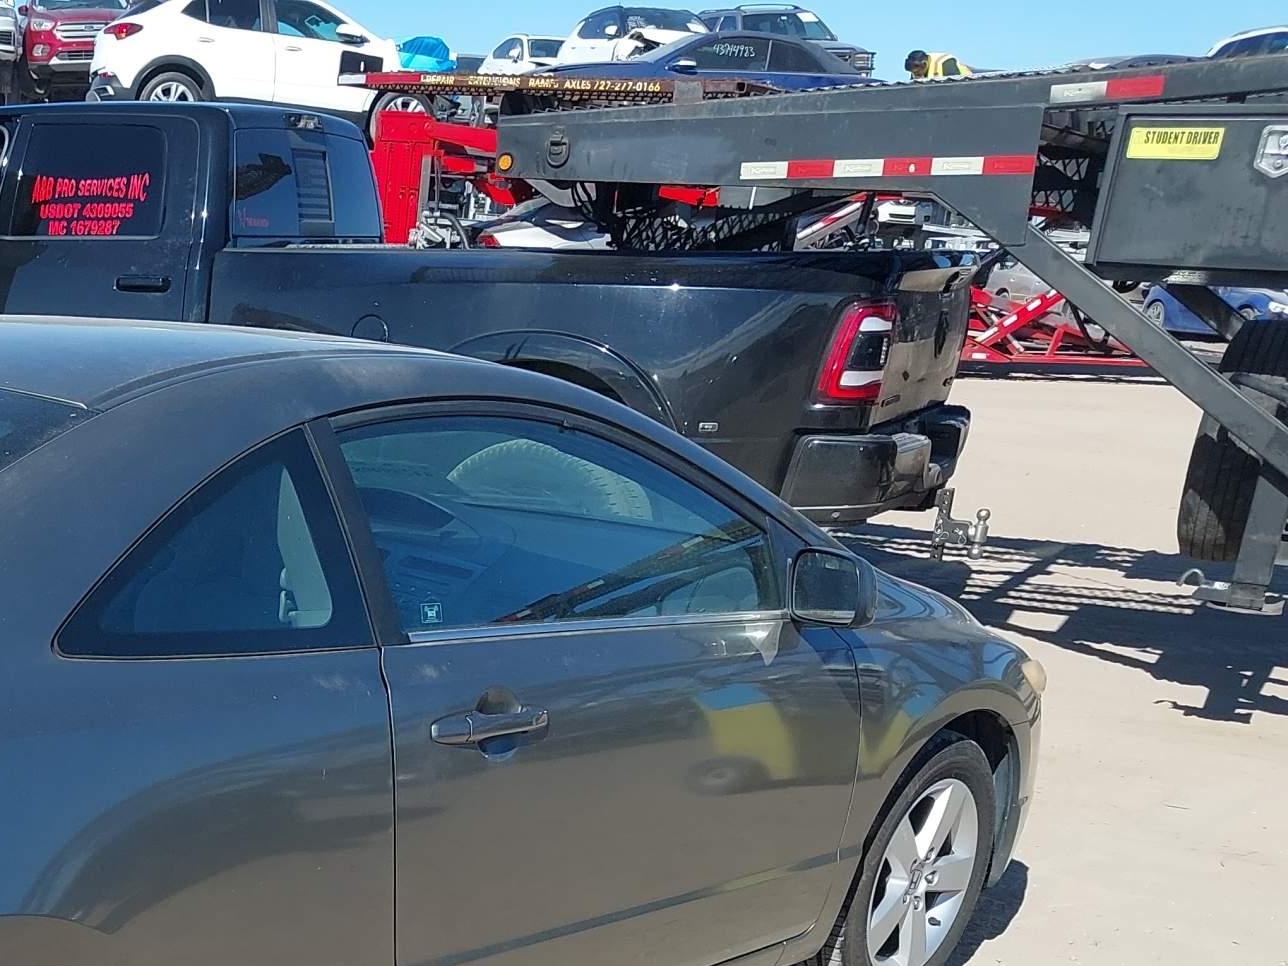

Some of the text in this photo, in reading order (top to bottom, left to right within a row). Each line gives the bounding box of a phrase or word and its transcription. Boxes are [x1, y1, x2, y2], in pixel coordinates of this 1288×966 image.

[563, 79, 592, 90] AXLES
[593, 80, 661, 92] 727-277-0166
[1144, 130, 1220, 145] STUDENT DRIVER
[54, 177, 76, 199] PRO
[77, 176, 128, 199] SERVICES
[128, 173, 150, 201] INC
[39, 202, 81, 219] USDOT
[47, 219, 121, 236] MC 1679287
